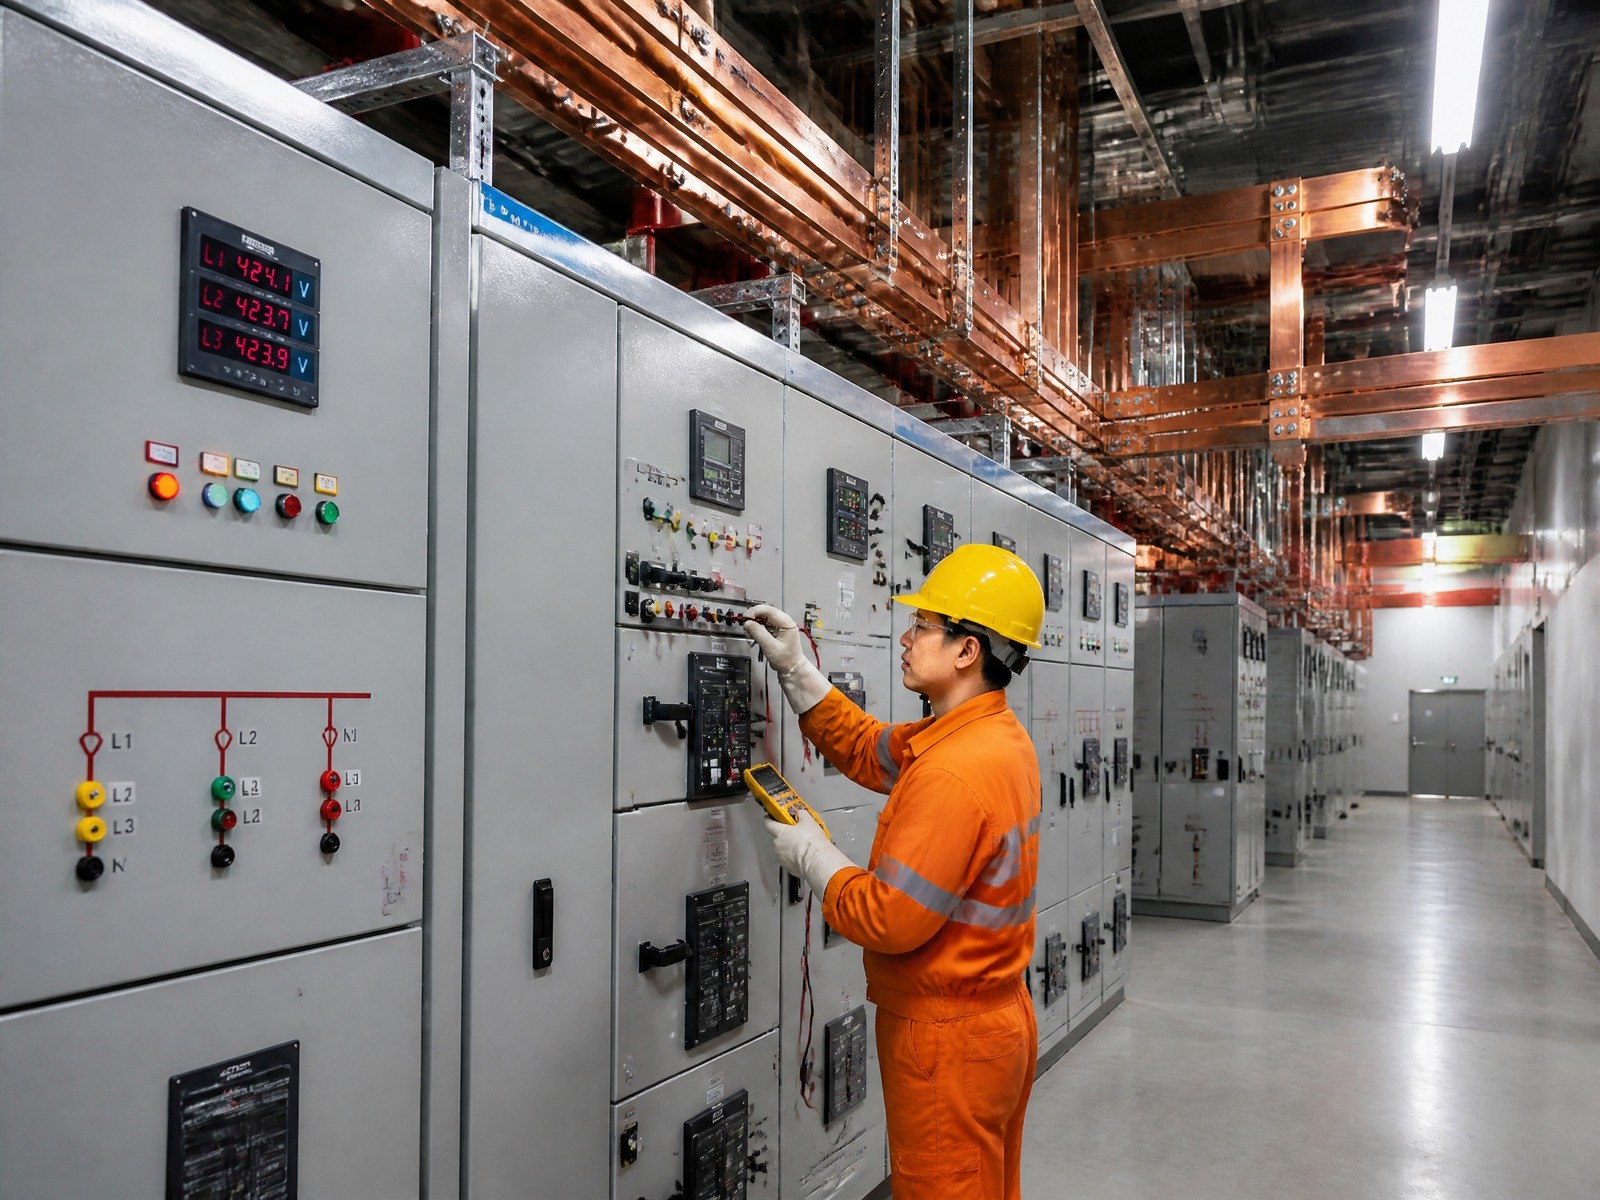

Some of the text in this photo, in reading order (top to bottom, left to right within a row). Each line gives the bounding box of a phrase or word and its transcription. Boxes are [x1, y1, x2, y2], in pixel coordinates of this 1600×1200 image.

[203, 243, 224, 268] L1
[237, 255, 291, 292] 424.1
[299, 280, 310, 298] V
[203, 285, 224, 309] L2
[236, 296, 289, 330] 423.7
[298, 318, 309, 336] V
[202, 326, 223, 350] L3
[235, 335, 289, 370] 423.9
[298, 357, 308, 373] V
[112, 732, 131, 749] L1
[239, 730, 257, 745] L2
[113, 787, 132, 803] L2
[113, 818, 135, 835] L3
